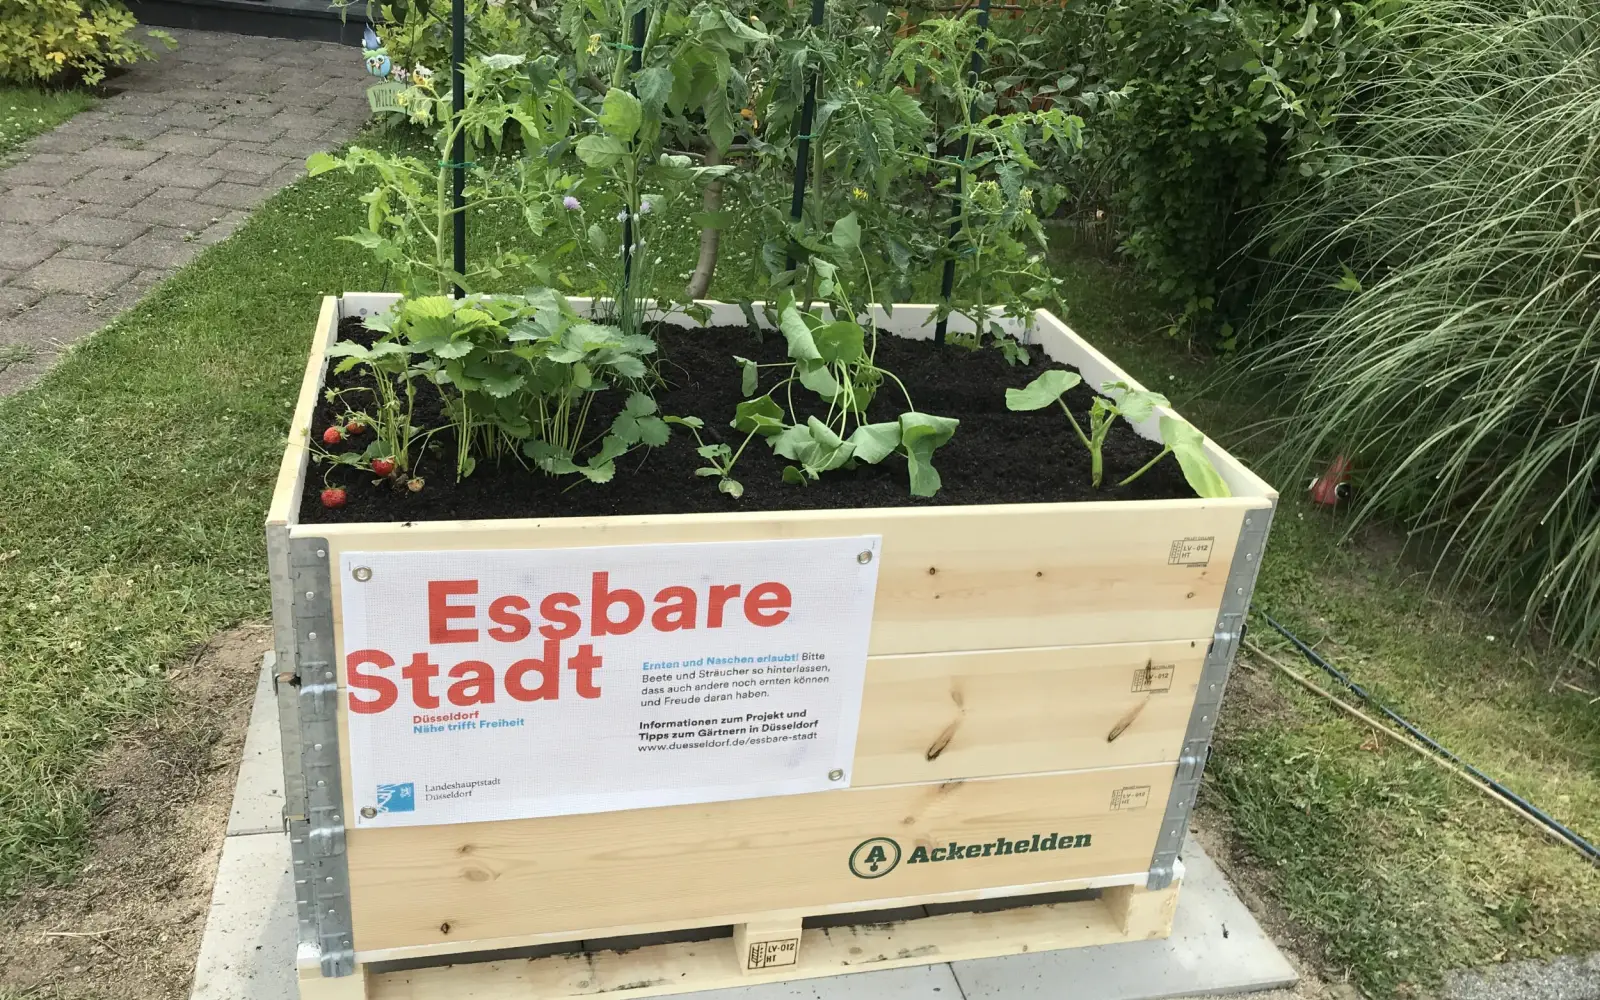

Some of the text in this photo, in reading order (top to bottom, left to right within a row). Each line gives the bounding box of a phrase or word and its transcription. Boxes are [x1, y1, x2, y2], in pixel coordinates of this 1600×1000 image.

[428, 571, 793, 644] Essbare
[642, 652, 825, 671] Ernten und Naschen erlaubt! Bitte
[346, 638, 603, 714] Stadt
[642, 673, 673, 683] Beete
[675, 671, 696, 681] und
[699, 667, 749, 679] Sträucher
[766, 664, 831, 674] hinterlassen,
[641, 675, 830, 695] dass auch andere noch ernten können
[641, 689, 770, 707] und Freude daran haben.
[413, 711, 480, 724] Düsseldorf
[413, 718, 525, 734] Nähe trifft Freiheit
[639, 709, 807, 730] Informationen zum Projekt und
[638, 720, 819, 742] Tipps zum Gärtnern in Düsseldorf
[637, 732, 818, 752] www.duesseldorf.de/essbare-stadt
[425, 778, 501, 792] Landeshauptstadt
[907, 832, 1092, 864] Ackerhelden
[768, 943, 795, 953] LV-012
[766, 955, 777, 963] HT
